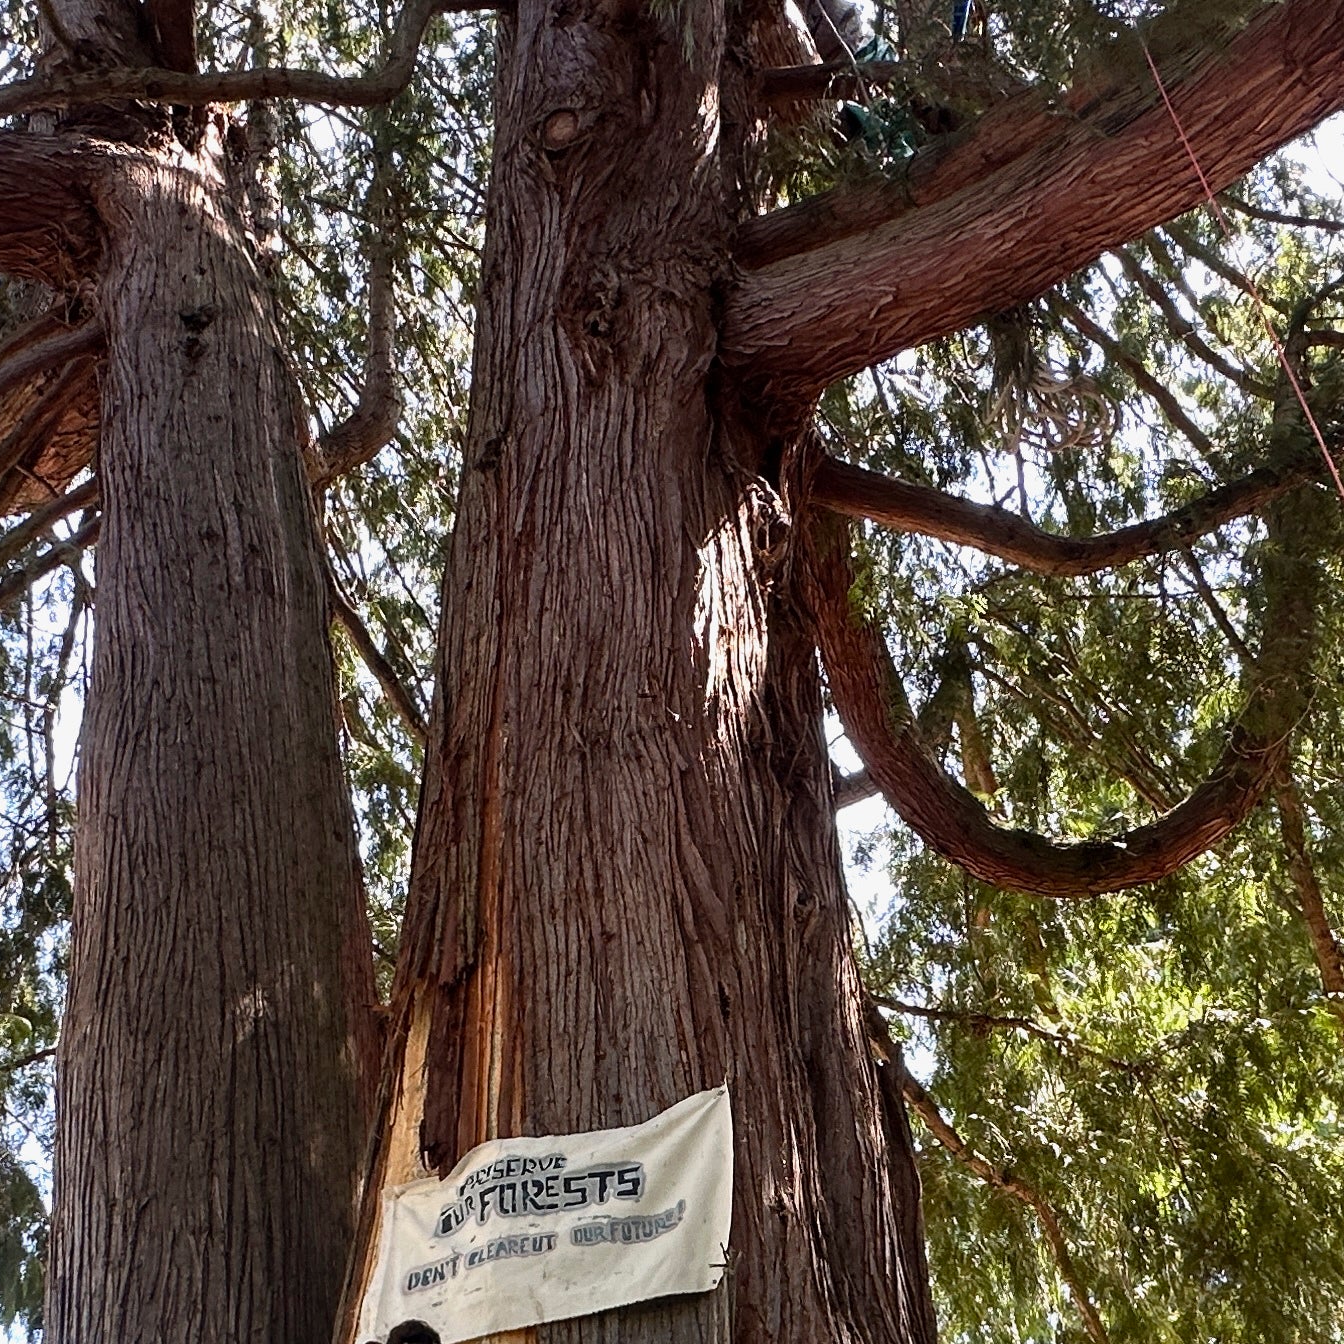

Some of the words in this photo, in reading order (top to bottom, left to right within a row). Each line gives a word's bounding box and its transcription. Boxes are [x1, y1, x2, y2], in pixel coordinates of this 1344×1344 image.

[459, 1157, 567, 1197] PRESERVE
[440, 1195, 476, 1234] OUR
[478, 1165, 643, 1221] FORESTS
[573, 1224, 608, 1243] OUR
[609, 1199, 686, 1242] FUTURE!
